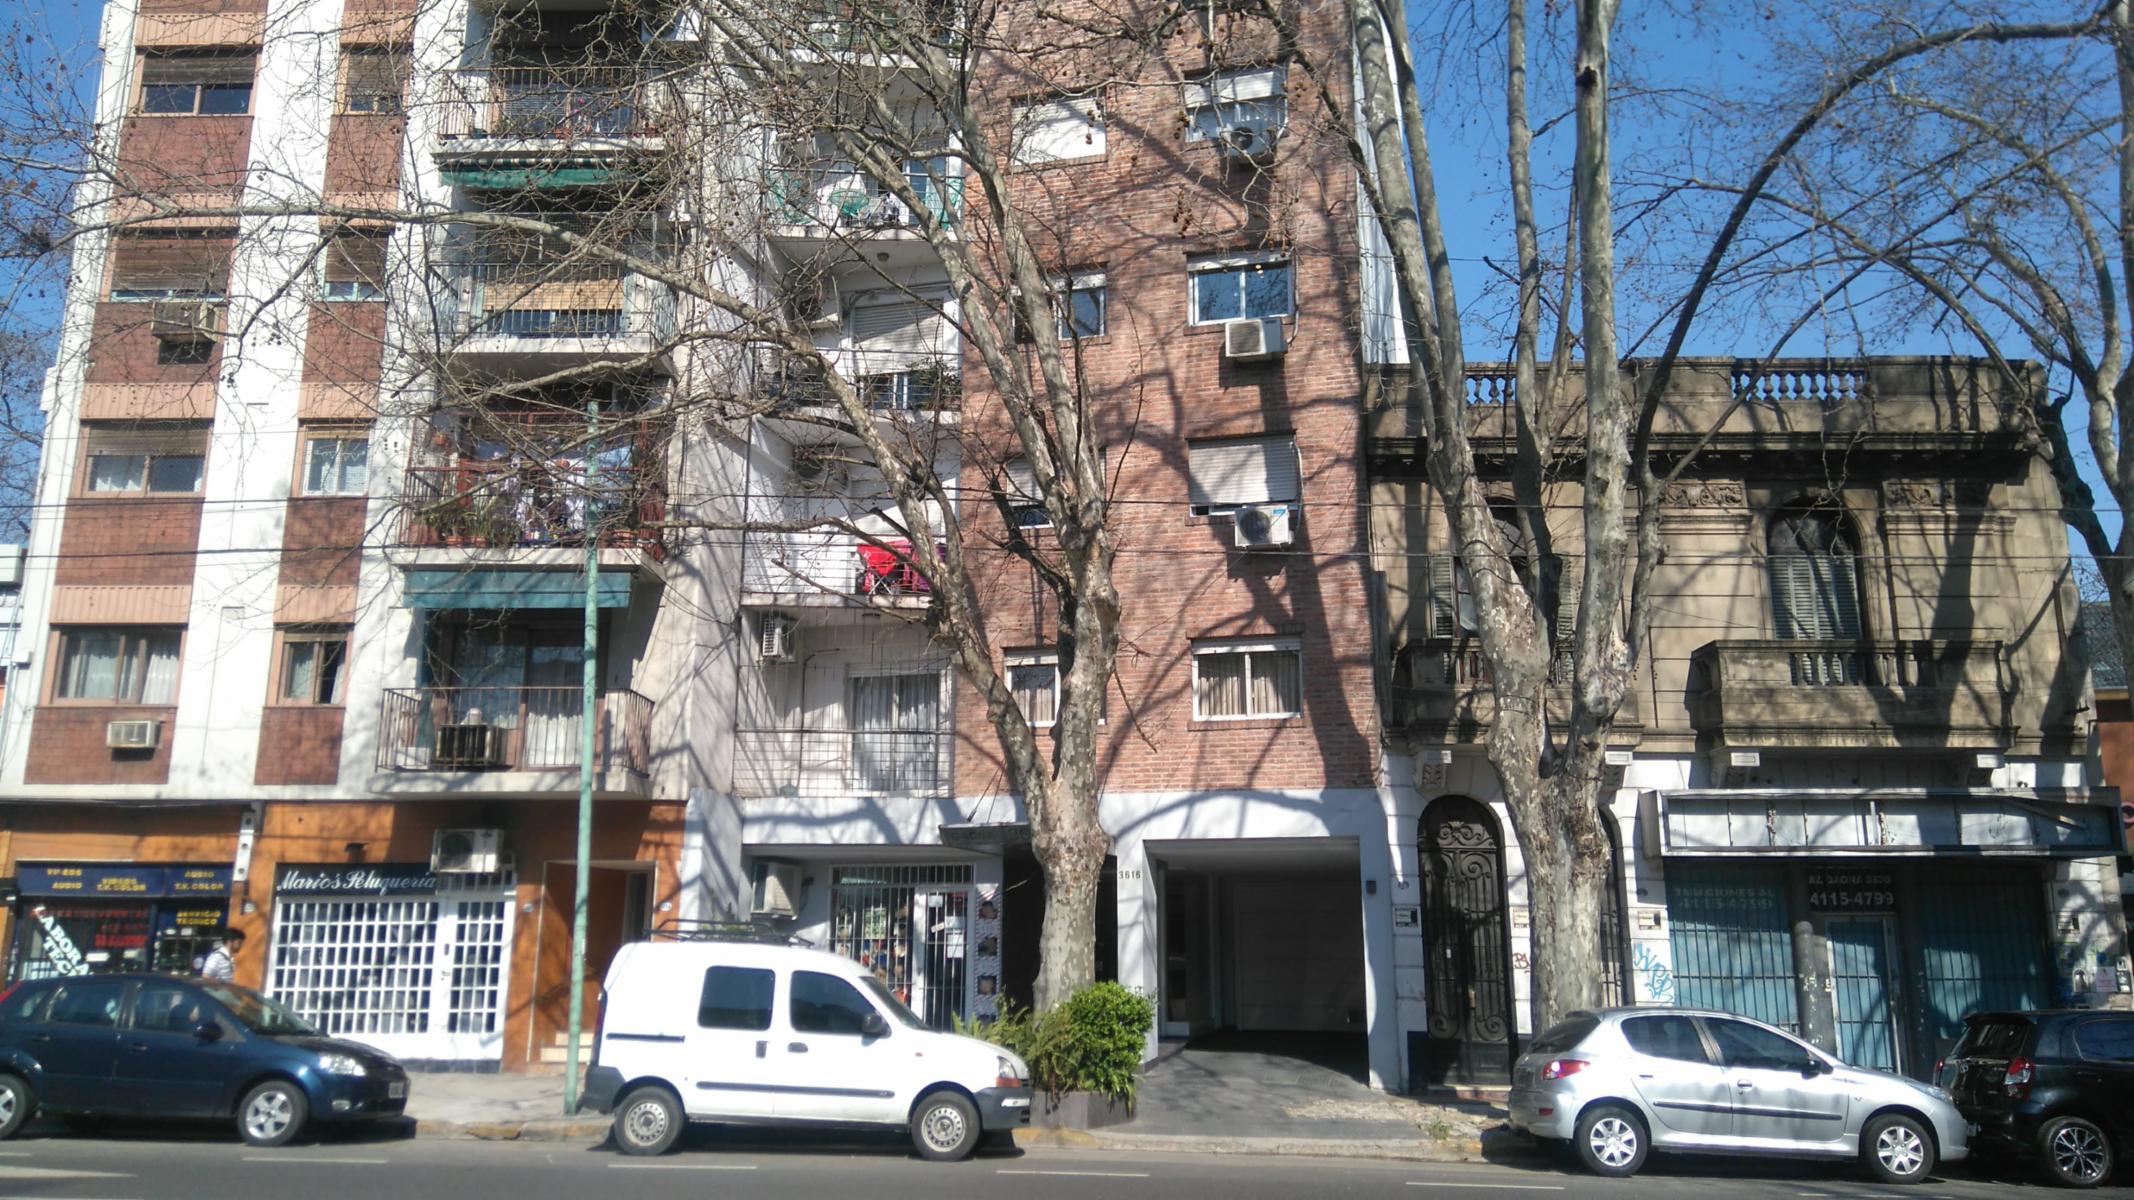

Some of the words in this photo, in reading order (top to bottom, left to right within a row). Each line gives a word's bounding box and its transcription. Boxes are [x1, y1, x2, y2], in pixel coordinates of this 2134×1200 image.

[276, 870, 341, 891] Mario's
[1118, 870, 1141, 879] 3616
[1809, 891, 1894, 906] 4115-4799
